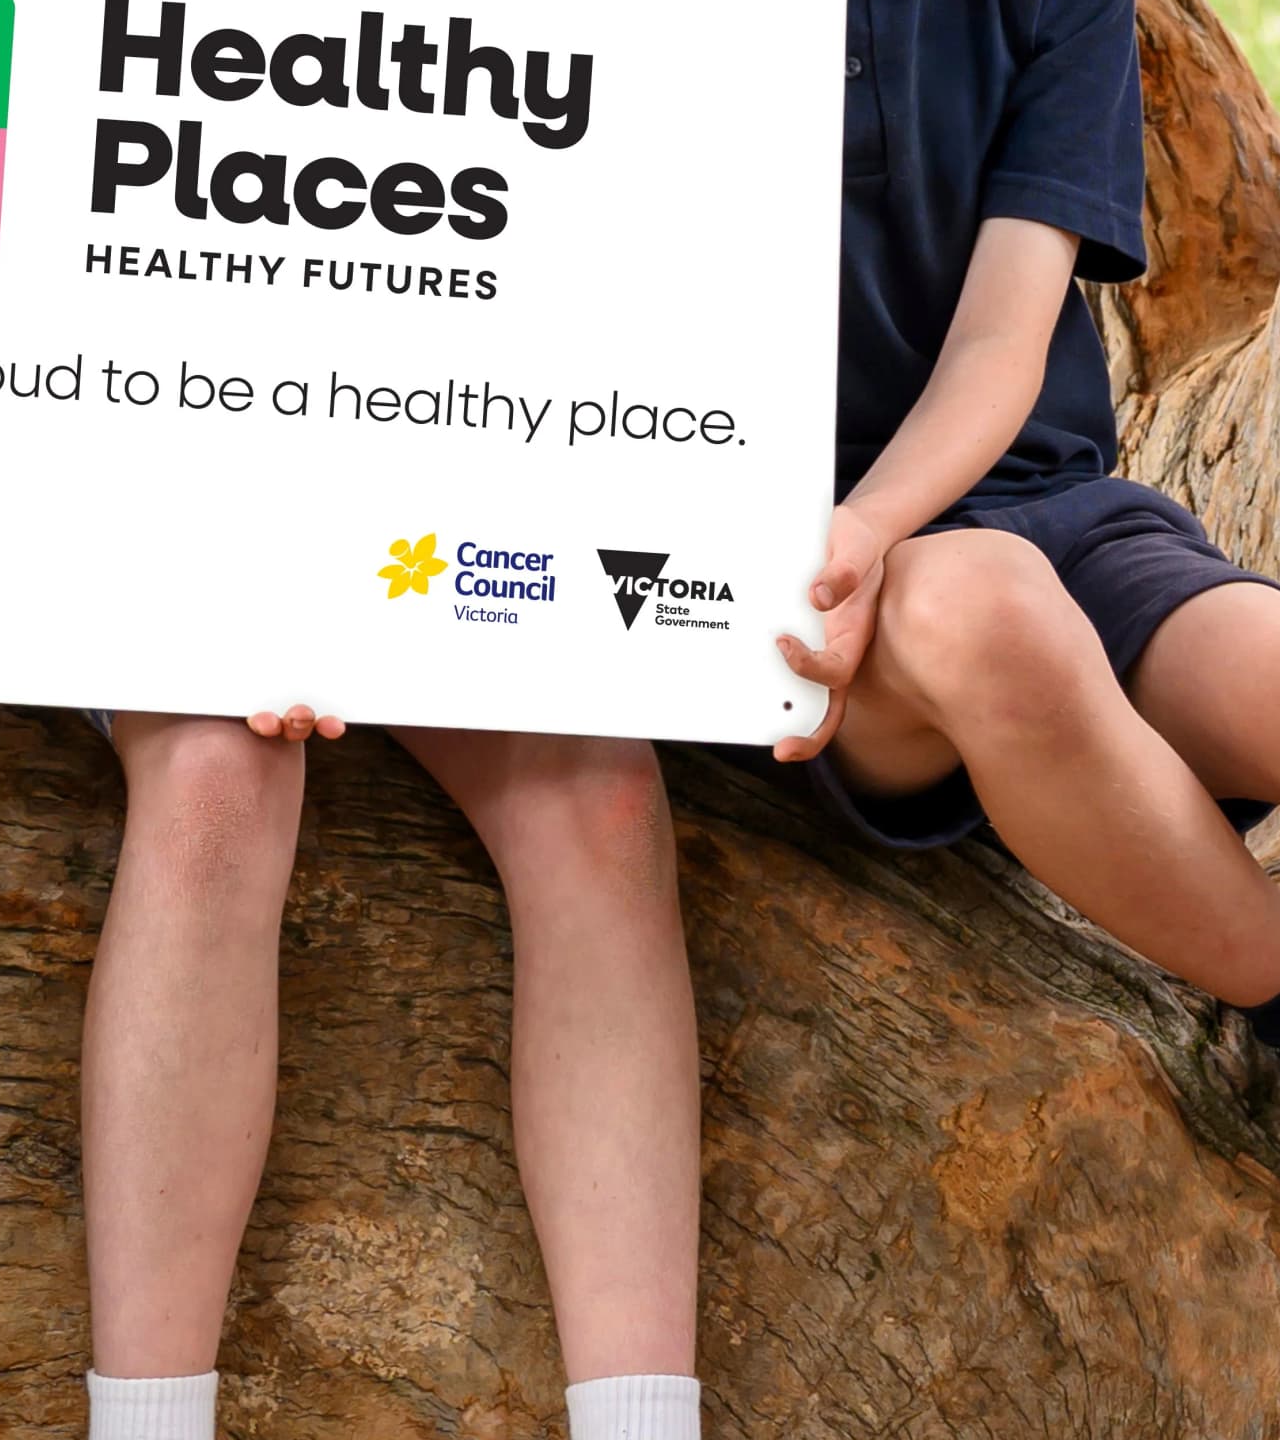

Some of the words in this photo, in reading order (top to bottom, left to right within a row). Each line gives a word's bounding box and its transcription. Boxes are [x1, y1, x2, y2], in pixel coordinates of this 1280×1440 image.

[91, 119, 509, 240] Places
[86, 244, 286, 286] HEALTHY
[304, 258, 497, 301] FUTURES
[101, 359, 160, 406] to
[179, 360, 254, 412] be
[272, 380, 309, 416] a
[329, 371, 553, 444] healthy
[568, 390, 746, 447] place.
[456, 541, 554, 572] Cancer
[454, 570, 556, 602] Council
[606, 574, 735, 603] VICTORIA
[454, 604, 518, 624] Victoria
[654, 614, 730, 630] Government
[655, 603, 690, 616] State
